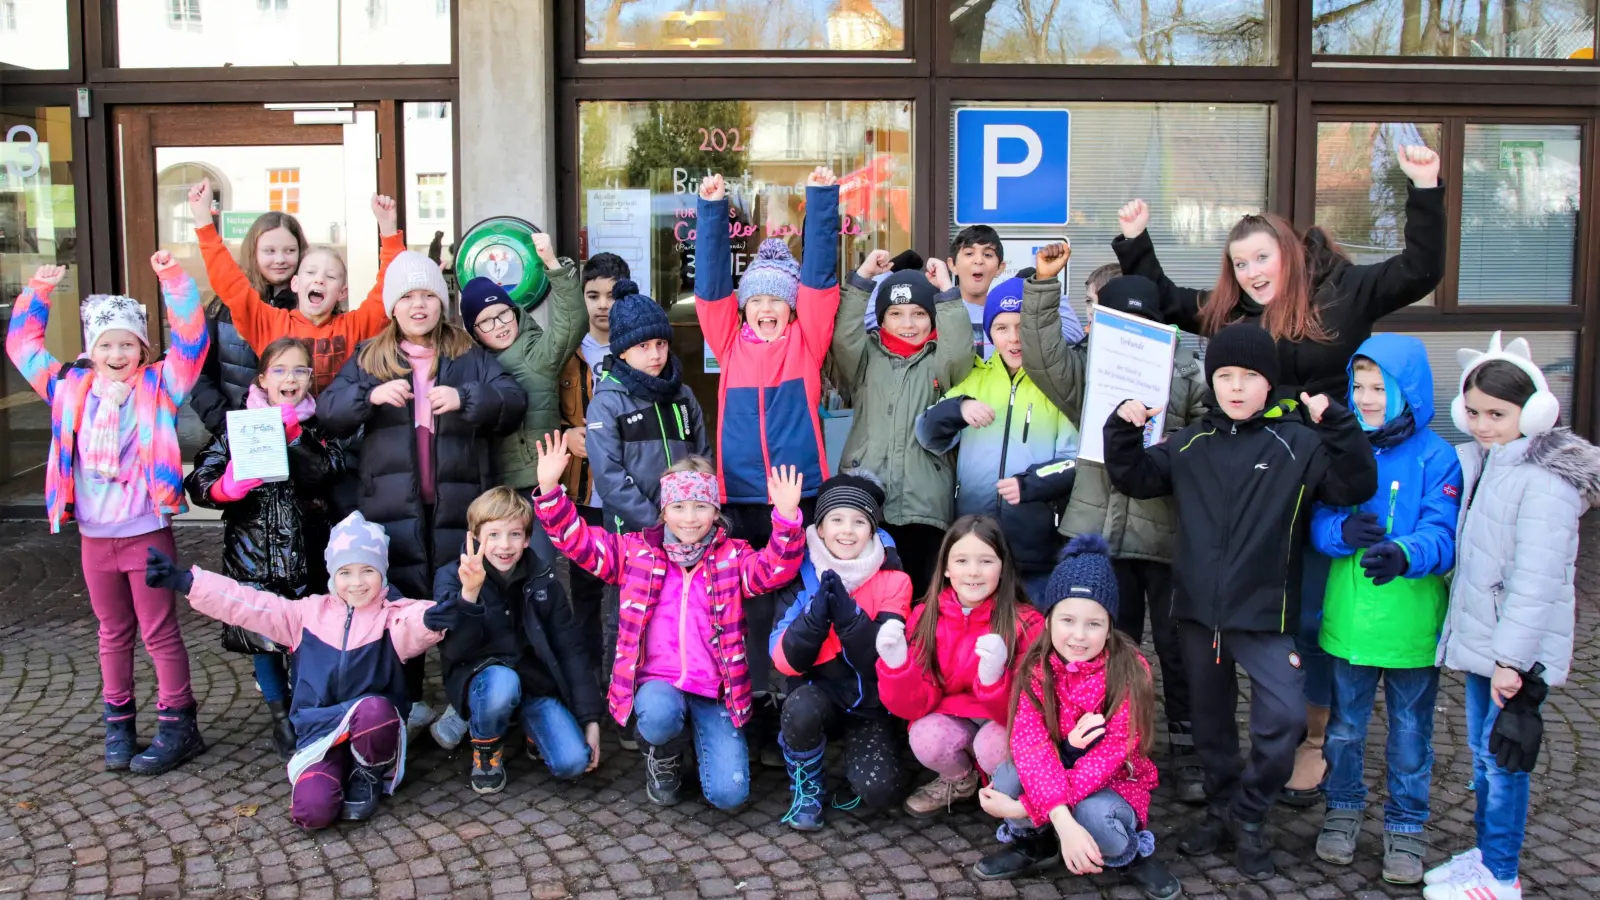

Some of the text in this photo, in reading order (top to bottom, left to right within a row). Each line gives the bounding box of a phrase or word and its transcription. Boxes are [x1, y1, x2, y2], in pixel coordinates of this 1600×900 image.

[6, 124, 41, 178] 3
[698, 127, 753, 152] 202
[983, 124, 1043, 210] P
[674, 208, 698, 218] TUR
[1000, 298, 1020, 306] ASV
